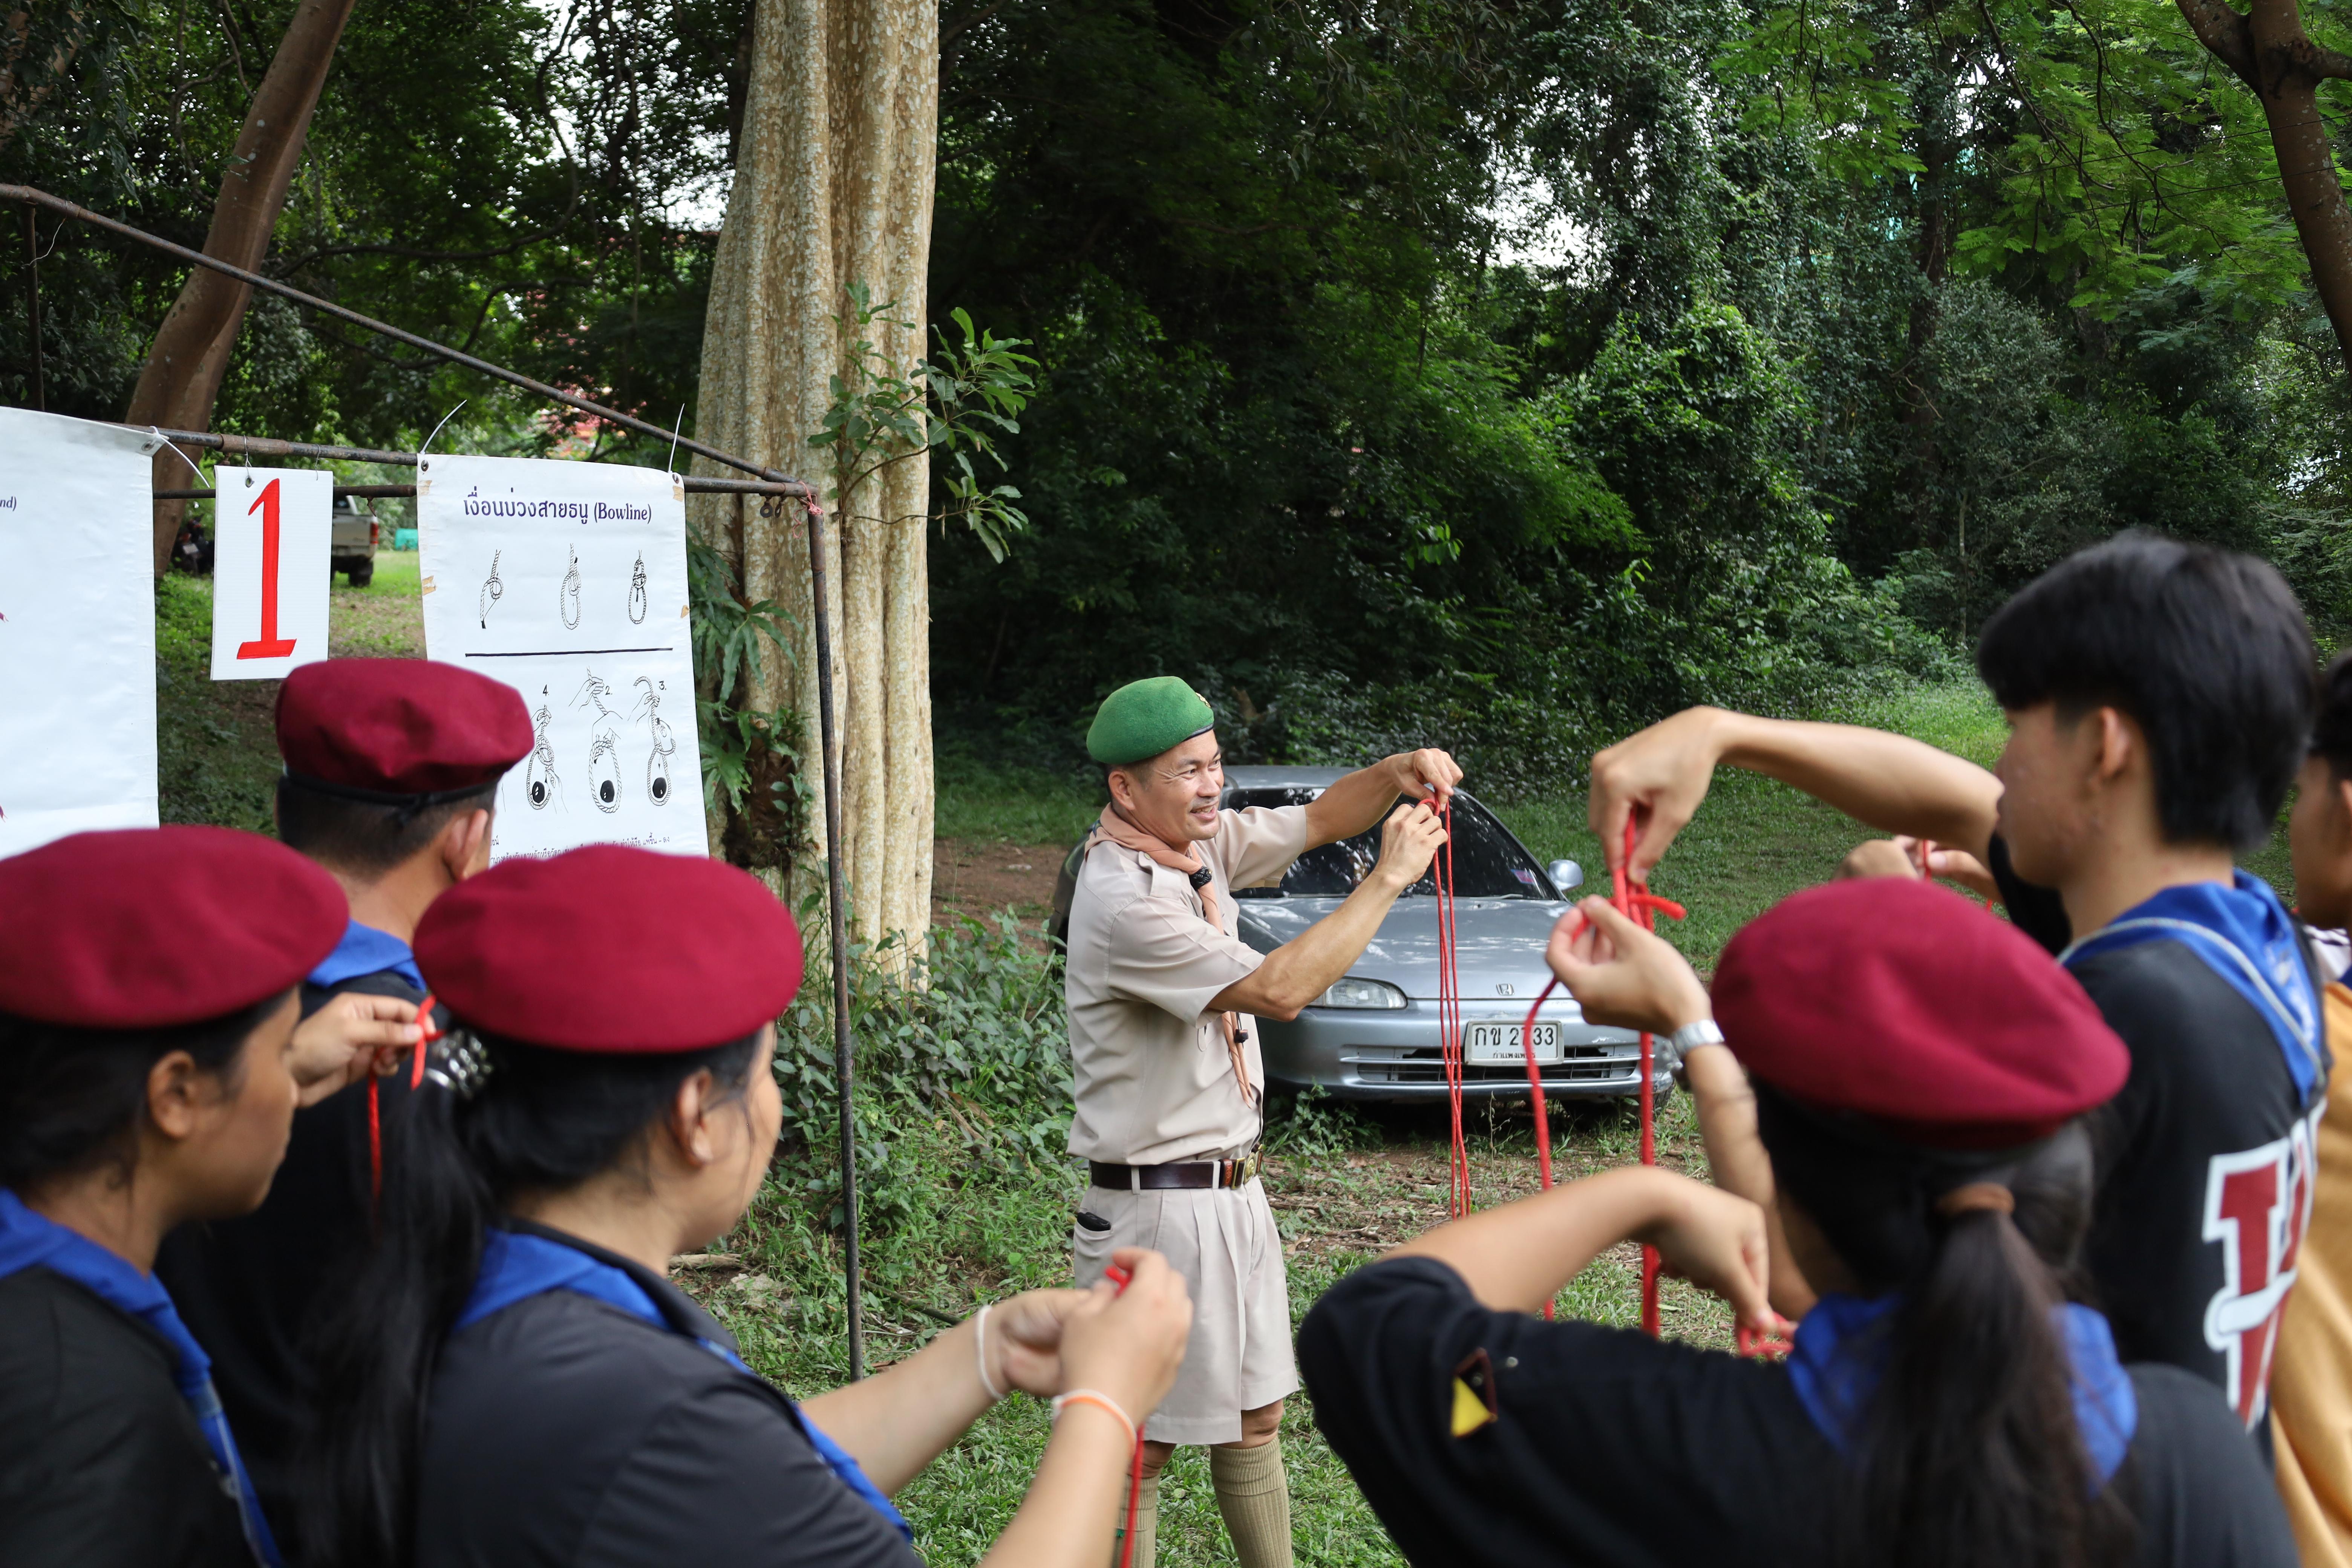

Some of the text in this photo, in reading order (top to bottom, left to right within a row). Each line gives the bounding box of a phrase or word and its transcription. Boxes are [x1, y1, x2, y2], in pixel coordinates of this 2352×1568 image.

[464, 485, 652, 524] เงื่อนบ่วงสายธนู (Bowline)
[237, 478, 297, 660] 1
[1509, 1027, 1554, 1046] 233
